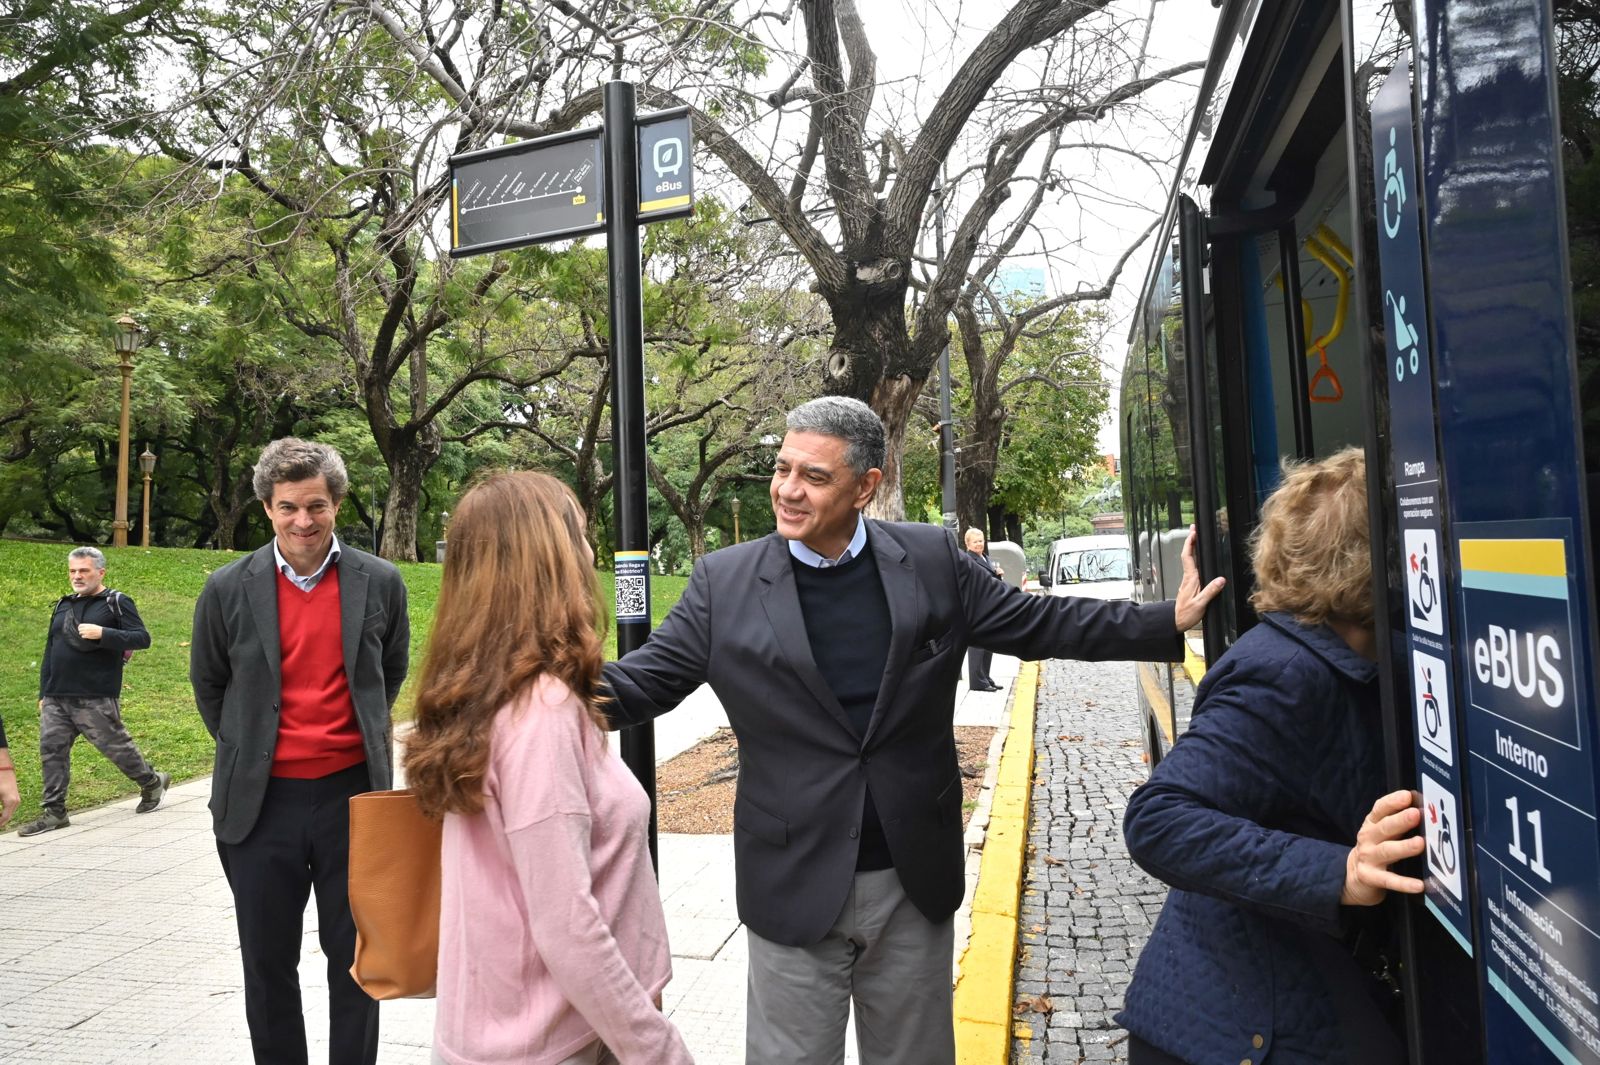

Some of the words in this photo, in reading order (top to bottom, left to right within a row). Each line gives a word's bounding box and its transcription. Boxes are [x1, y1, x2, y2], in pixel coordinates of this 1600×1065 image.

[655, 181, 682, 193] eBus
[1404, 461, 1426, 477] Rampa
[1474, 624, 1565, 709] eBUS
[1495, 728, 1549, 779] Interno
[1505, 796, 1552, 884] 11
[1505, 884, 1563, 946] Información
[1487, 897, 1501, 918] Más
[1500, 908, 1539, 953] información
[1544, 952, 1599, 1005] sugerencias
